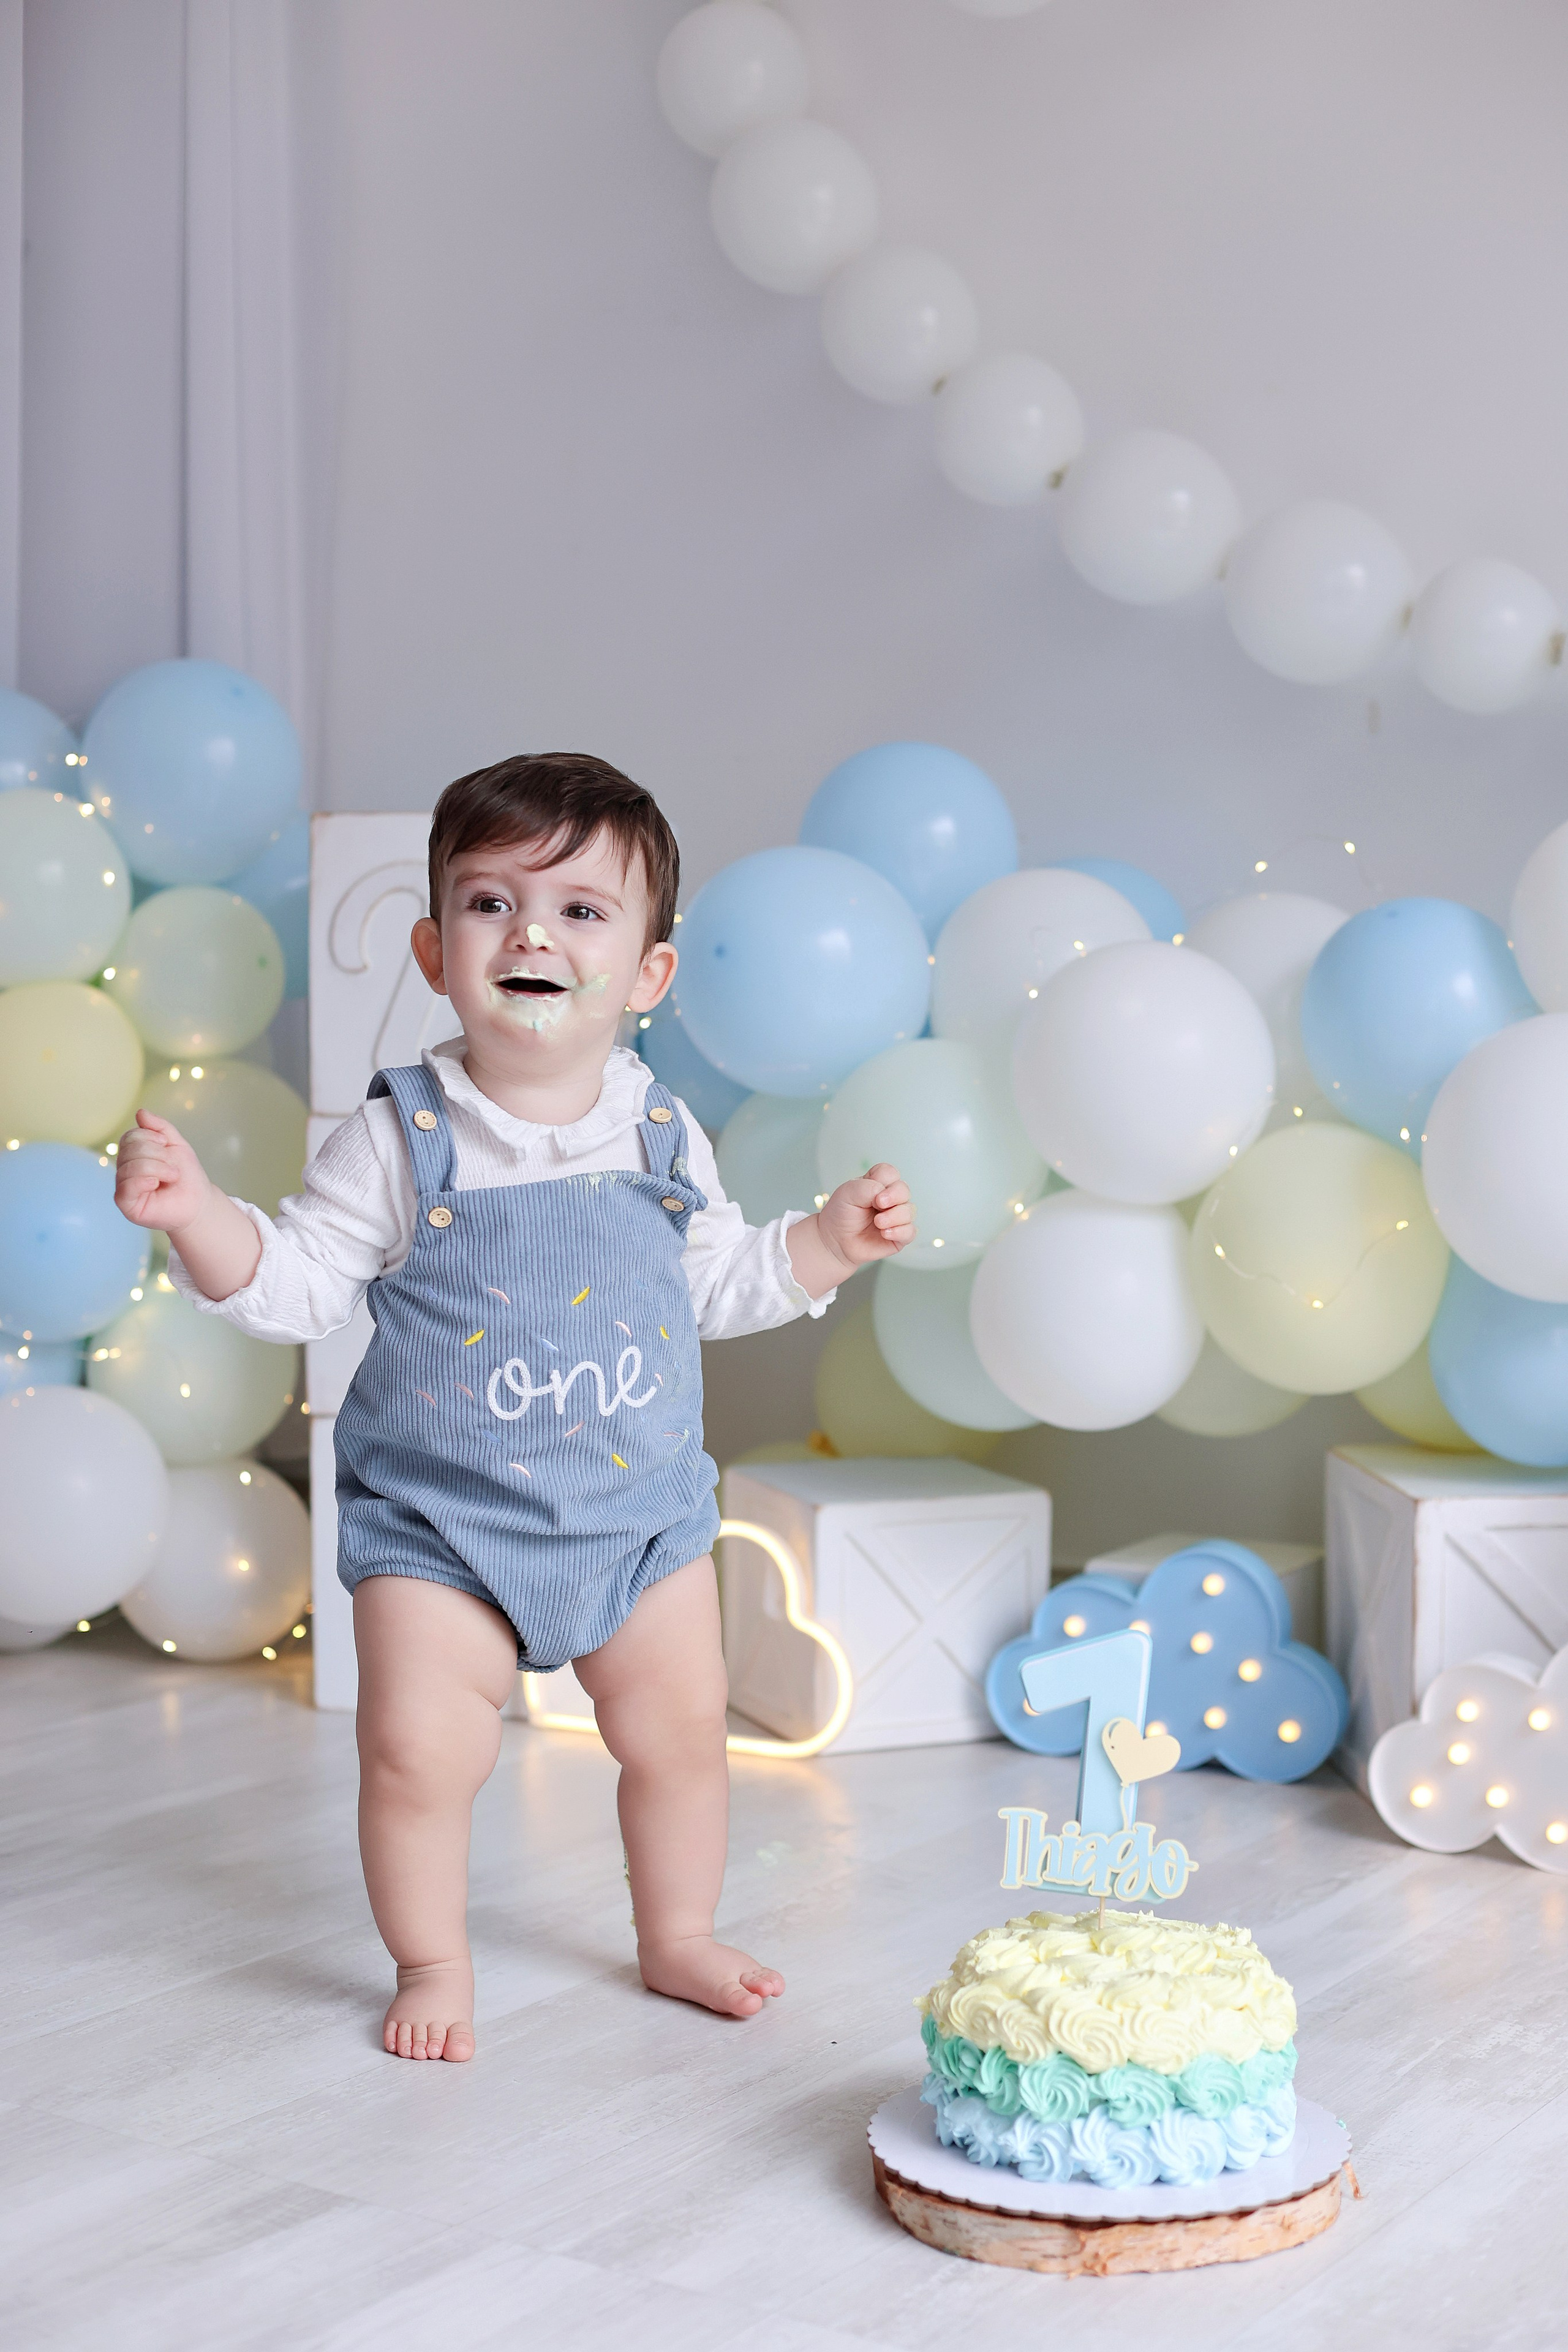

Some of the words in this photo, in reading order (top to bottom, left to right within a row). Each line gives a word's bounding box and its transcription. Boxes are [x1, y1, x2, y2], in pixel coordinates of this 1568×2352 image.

[487, 1346, 657, 1421] one
[1018, 1628, 1166, 1904] 1
[997, 1806, 1200, 1902] Thiago
